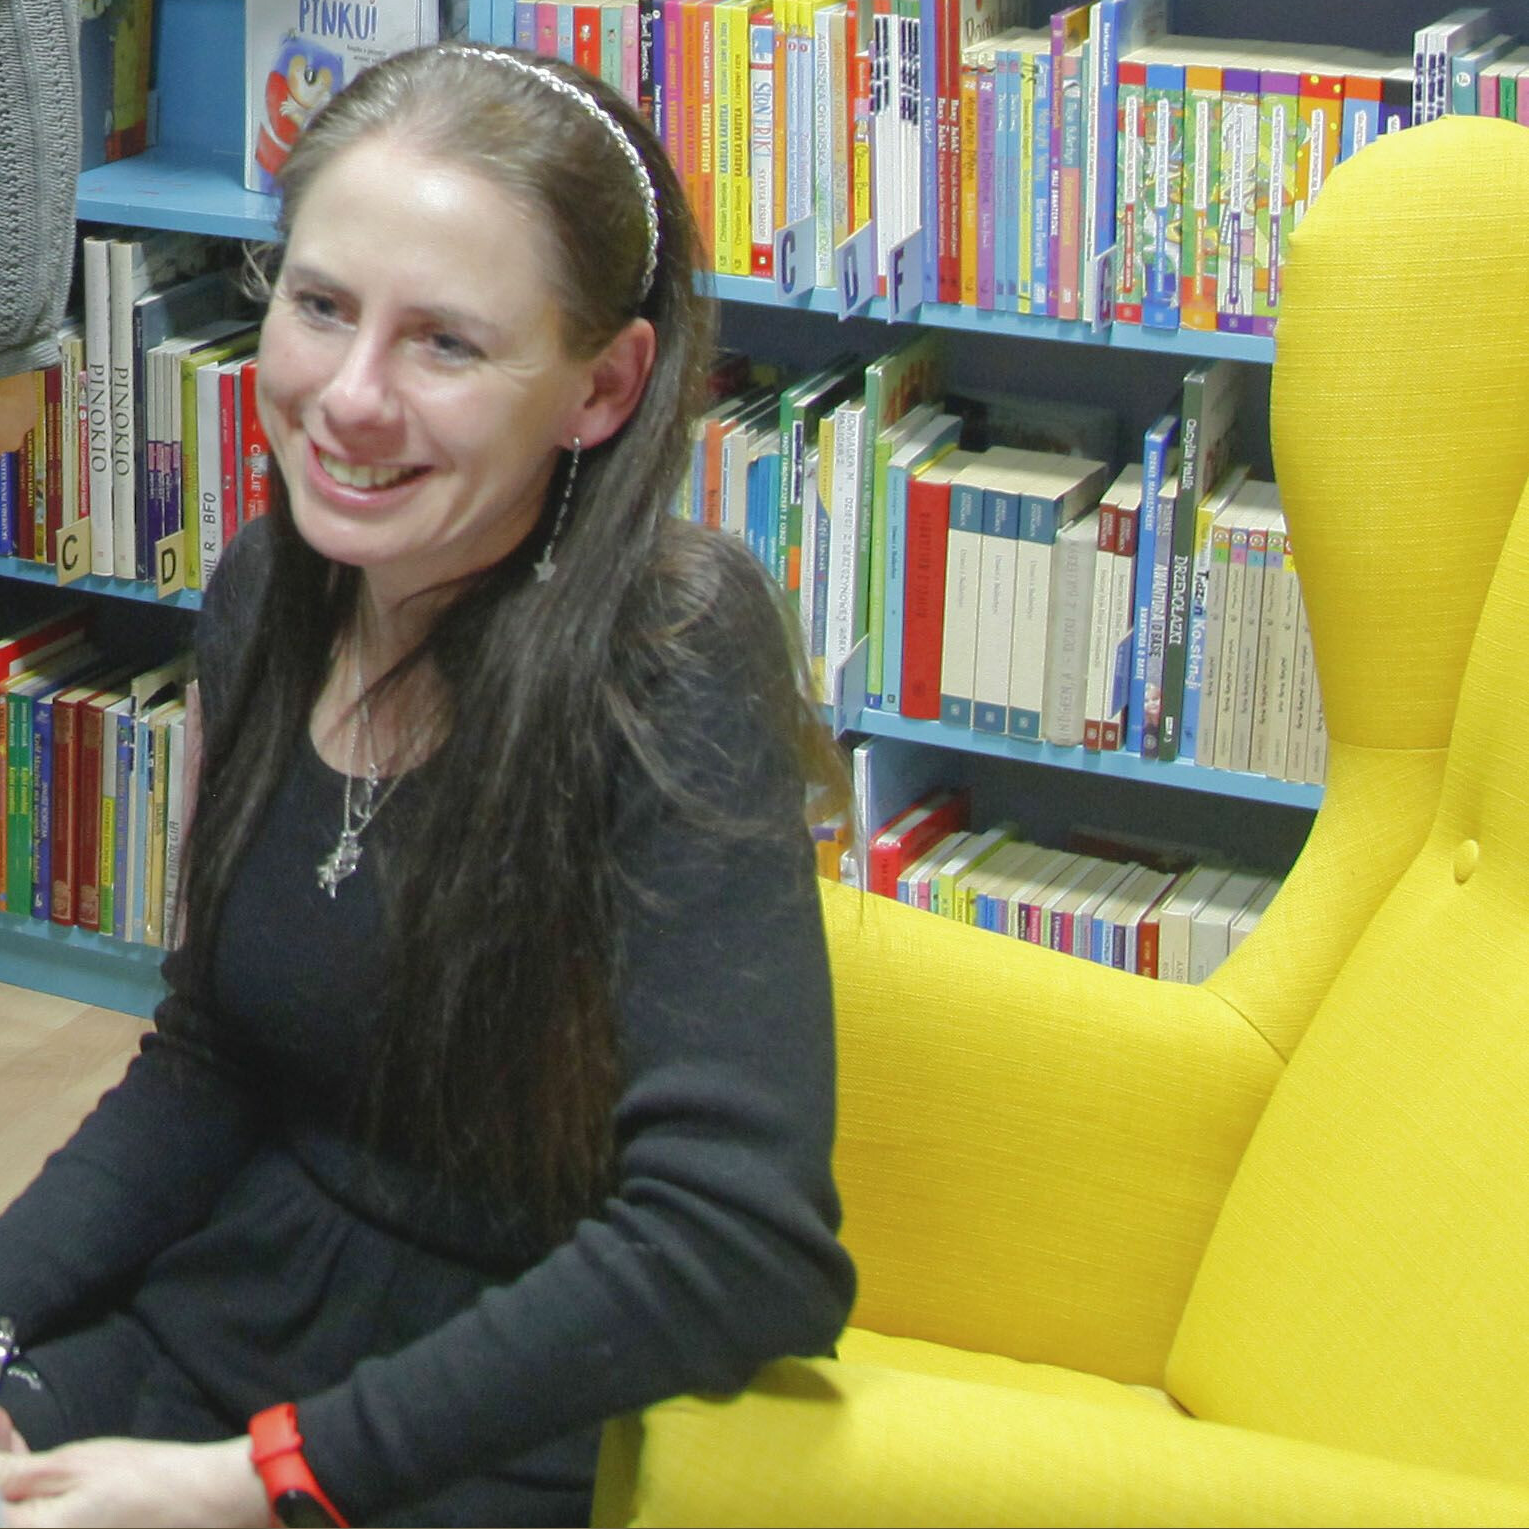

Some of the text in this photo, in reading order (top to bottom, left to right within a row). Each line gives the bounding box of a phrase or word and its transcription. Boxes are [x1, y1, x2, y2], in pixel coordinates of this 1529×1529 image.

[817, 33, 827, 98] AGNIESZKA
[734, 144, 743, 177] KAROLKA
[758, 168, 767, 237] SYLVIA BISHOP
[781, 230, 796, 294] C
[844, 243, 859, 309] D
[89, 364, 107, 472] PINOKIO
[114, 367, 130, 476] PINOKIO
[62, 535, 78, 570] C
[161, 547, 176, 585] D
[1151, 563, 1168, 620] AWANTURA
[1169, 555, 1189, 645] DRZEWOŁAZKI
